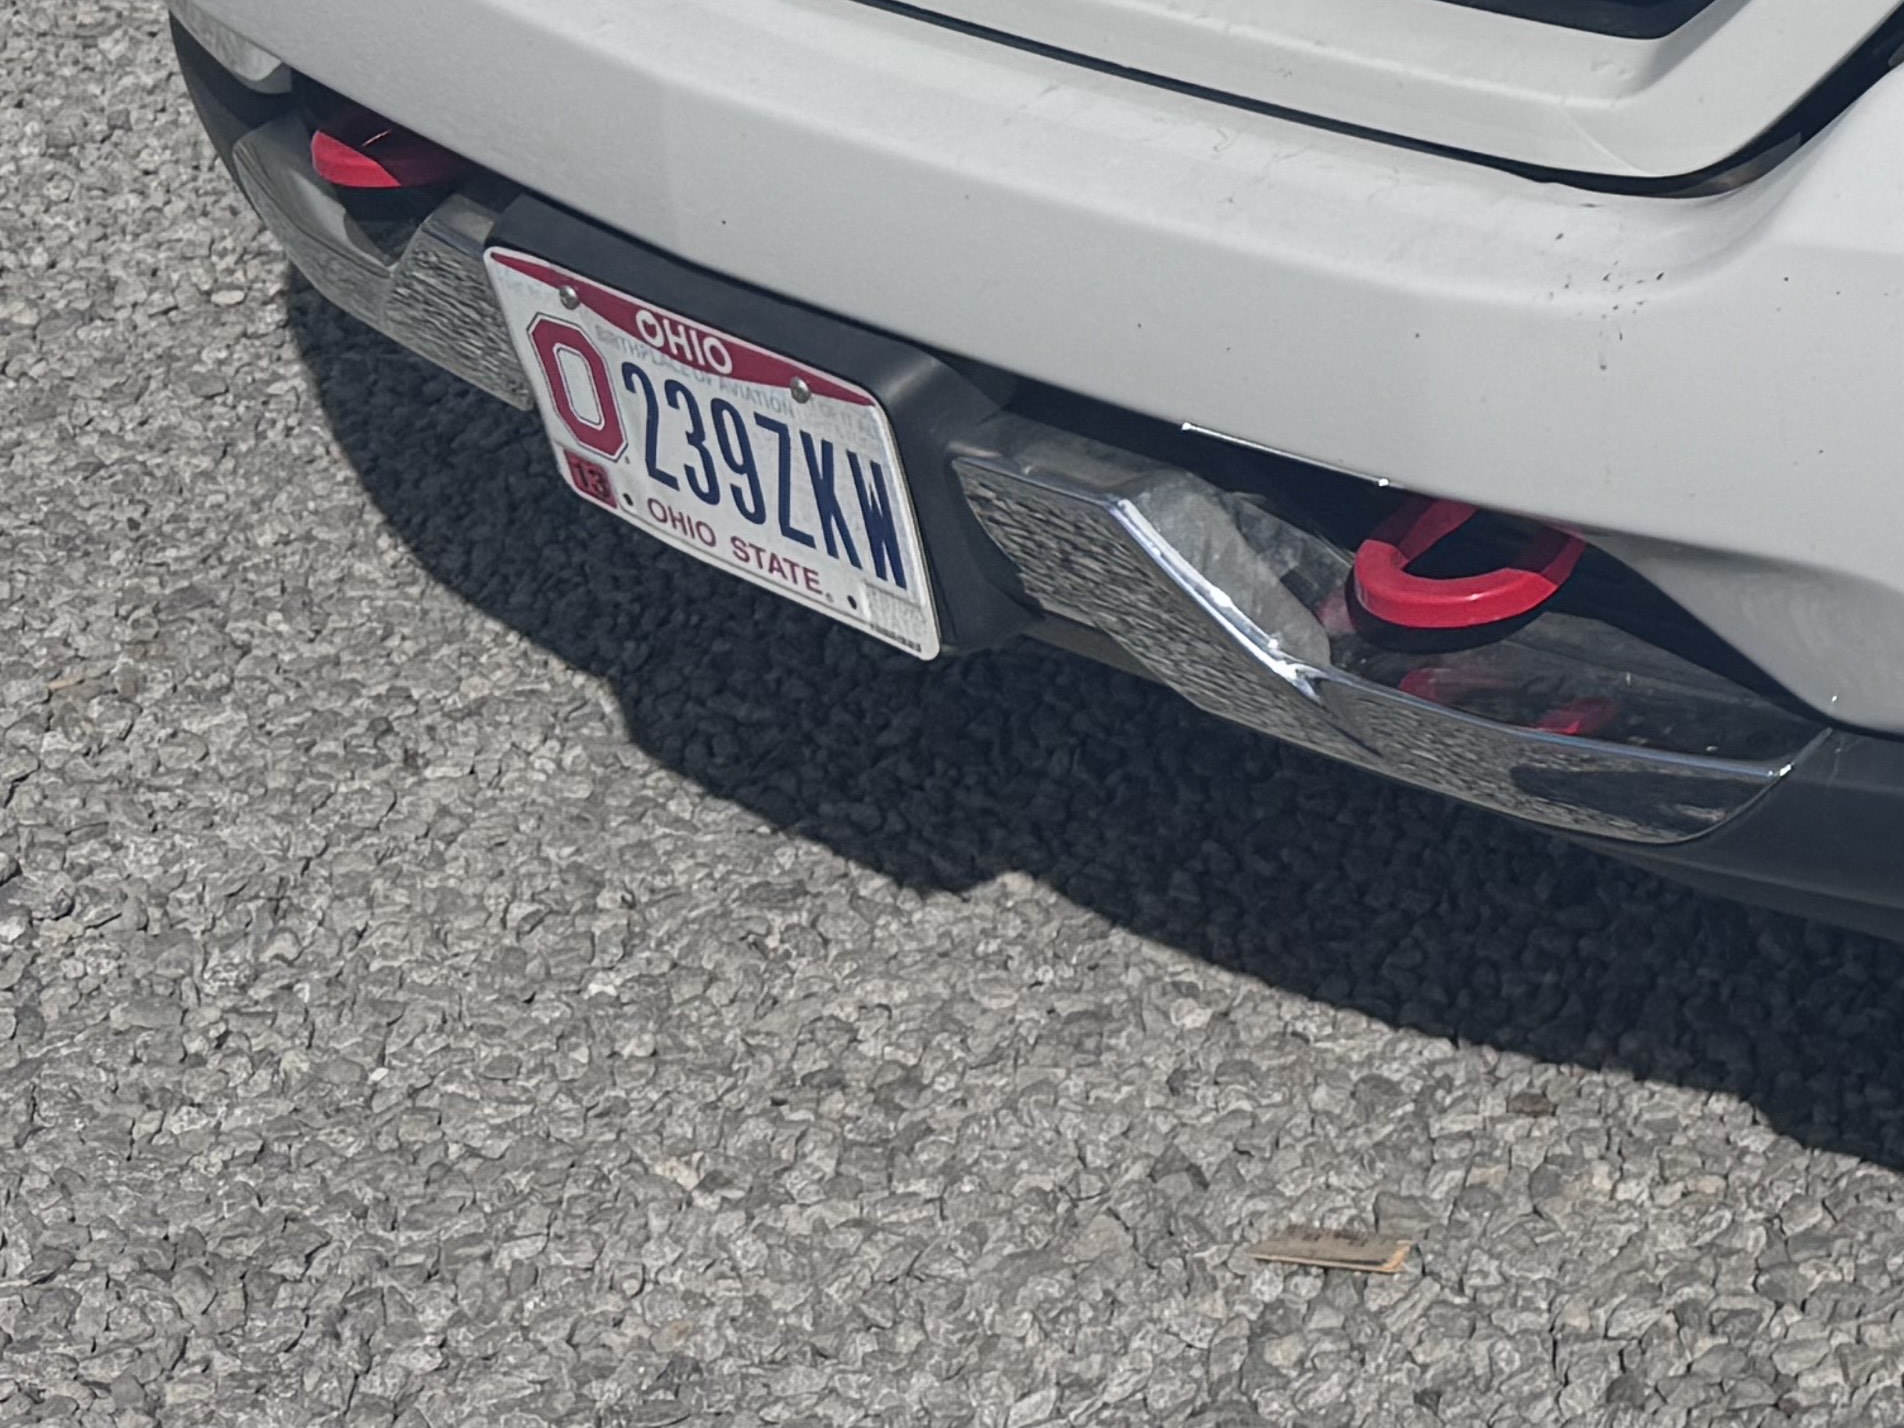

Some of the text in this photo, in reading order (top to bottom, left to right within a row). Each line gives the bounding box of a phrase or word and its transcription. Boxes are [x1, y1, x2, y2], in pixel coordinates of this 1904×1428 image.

[634, 309, 734, 377] OHIO
[620, 360, 908, 591] 239ZKW
[646, 496, 822, 595] OHIO STATE
